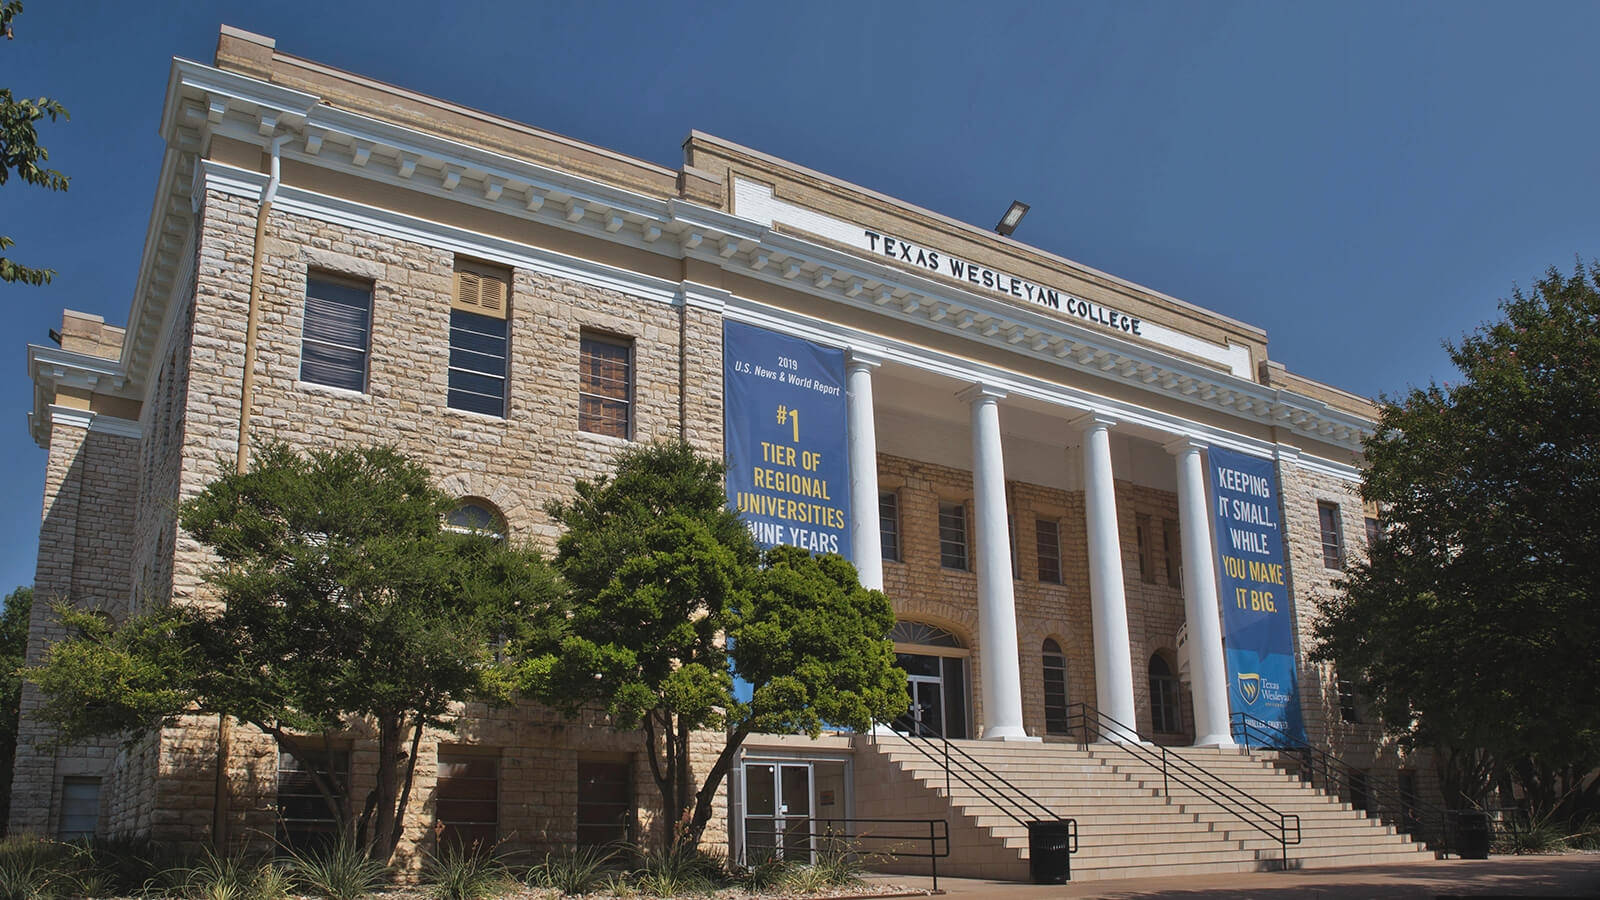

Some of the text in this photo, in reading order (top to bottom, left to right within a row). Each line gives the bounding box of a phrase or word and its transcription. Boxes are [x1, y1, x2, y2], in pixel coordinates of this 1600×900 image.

[865, 231, 1142, 336] TEXAS WESLEYAN COLLEGE
[735, 361, 840, 396] U.S. News & World Report
[778, 356, 798, 371] 2019
[776, 404, 799, 442] #1
[761, 441, 821, 472] TIER OF
[754, 466, 831, 500] REGIONAL
[1218, 467, 1270, 498] KEEPING
[737, 491, 845, 529] UNIVERSITIES
[1219, 495, 1277, 530] IT SMALL,
[789, 527, 839, 554] YEARS
[1230, 527, 1270, 555] WHILE
[1222, 554, 1285, 585] YOU MAKE
[1235, 587, 1278, 613] IT BIG.
[1260, 677, 1280, 690] Texas
